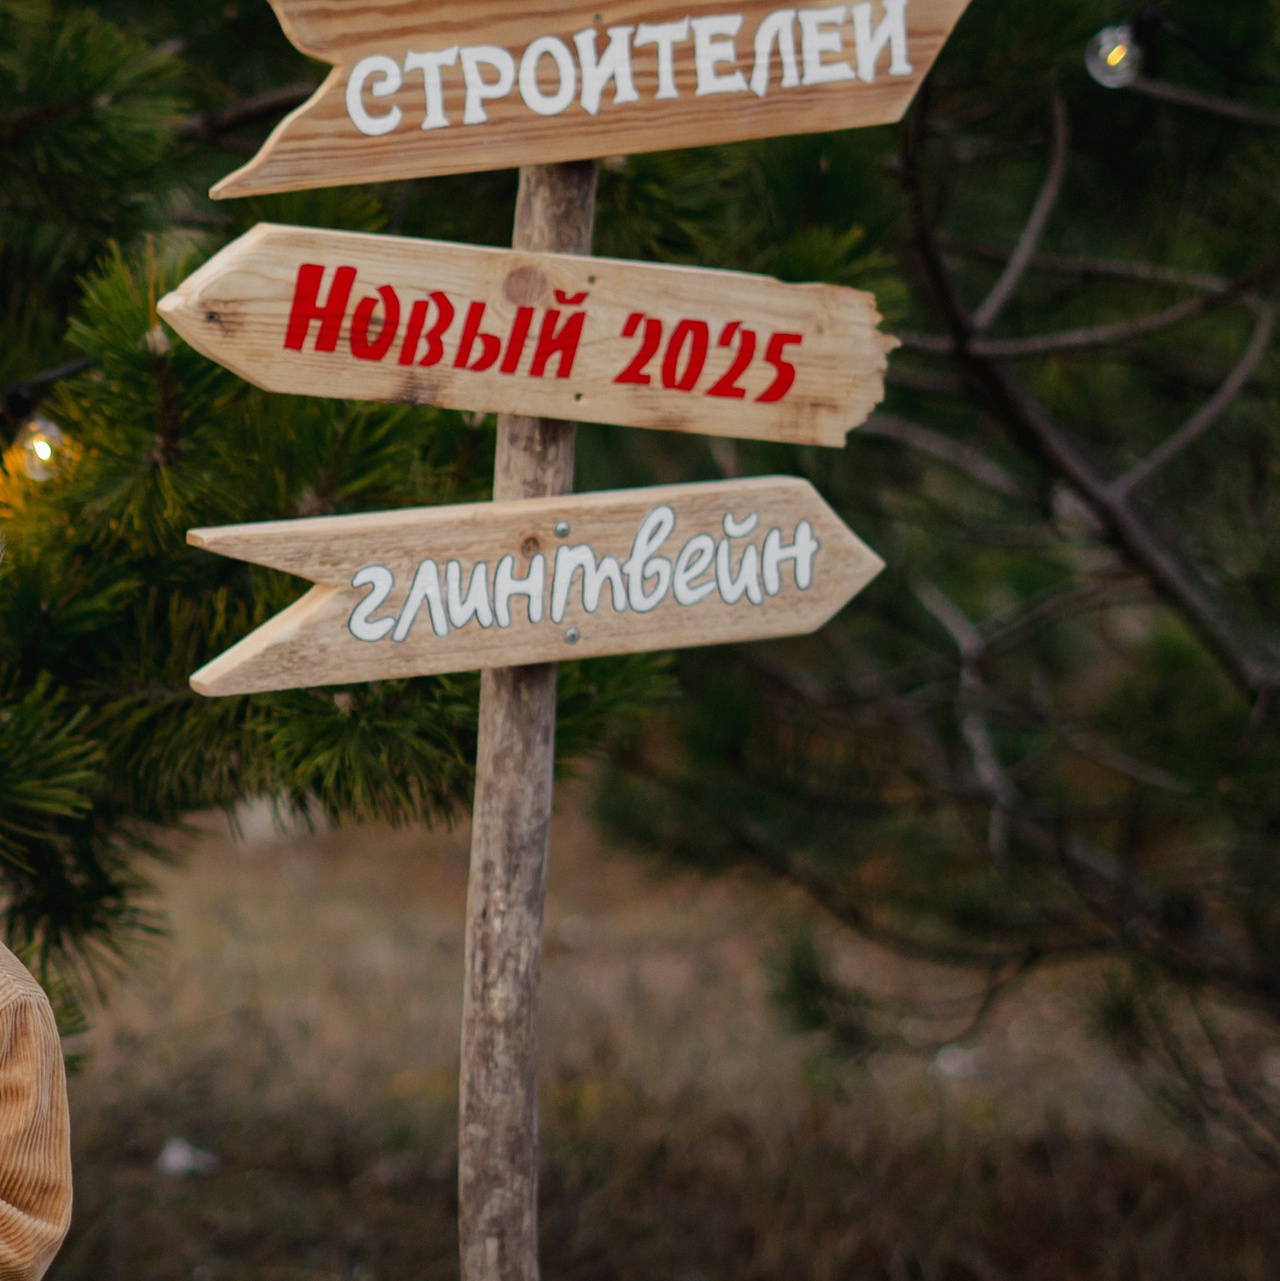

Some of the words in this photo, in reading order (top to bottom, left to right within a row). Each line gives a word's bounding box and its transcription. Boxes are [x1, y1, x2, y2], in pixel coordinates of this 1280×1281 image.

[283, 263, 587, 378] Новый
[615, 312, 803, 402] 2025
[348, 506, 819, 643] глинтвейн
